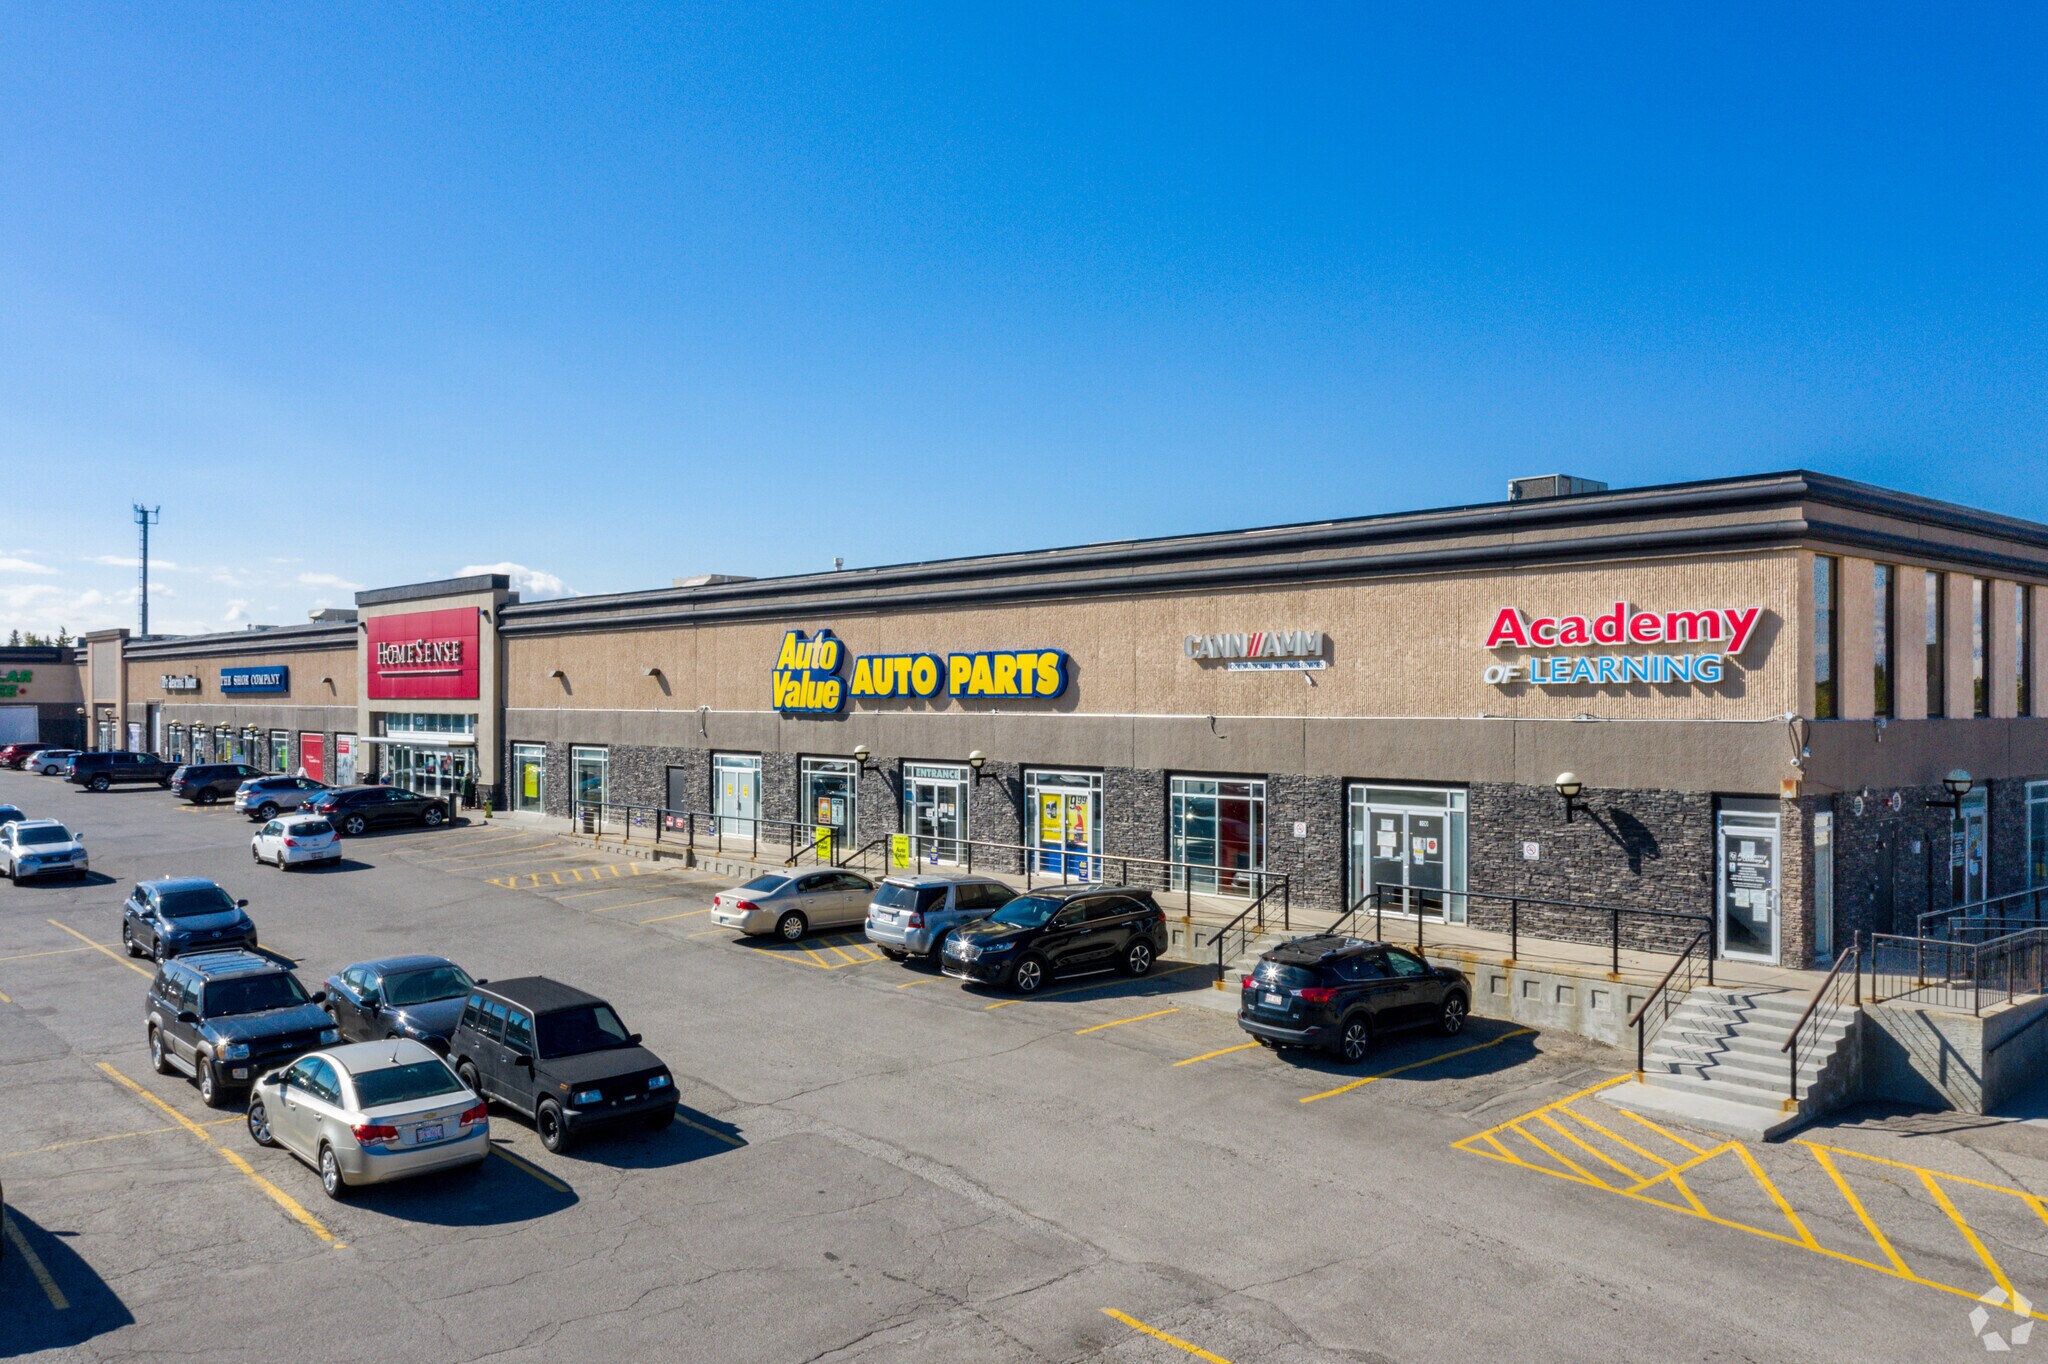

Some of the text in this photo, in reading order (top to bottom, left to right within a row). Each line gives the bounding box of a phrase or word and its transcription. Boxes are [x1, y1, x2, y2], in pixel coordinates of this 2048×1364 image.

[1485, 601, 1763, 654] Academy
[776, 631, 837, 670] Auto
[1484, 655, 1724, 684] OF LEARNING
[220, 673, 280, 686] THE SHOE COMPANY
[773, 668, 840, 709] Value
[851, 652, 1060, 695] AUTO PARTS
[915, 767, 960, 779] ENTRANCE
